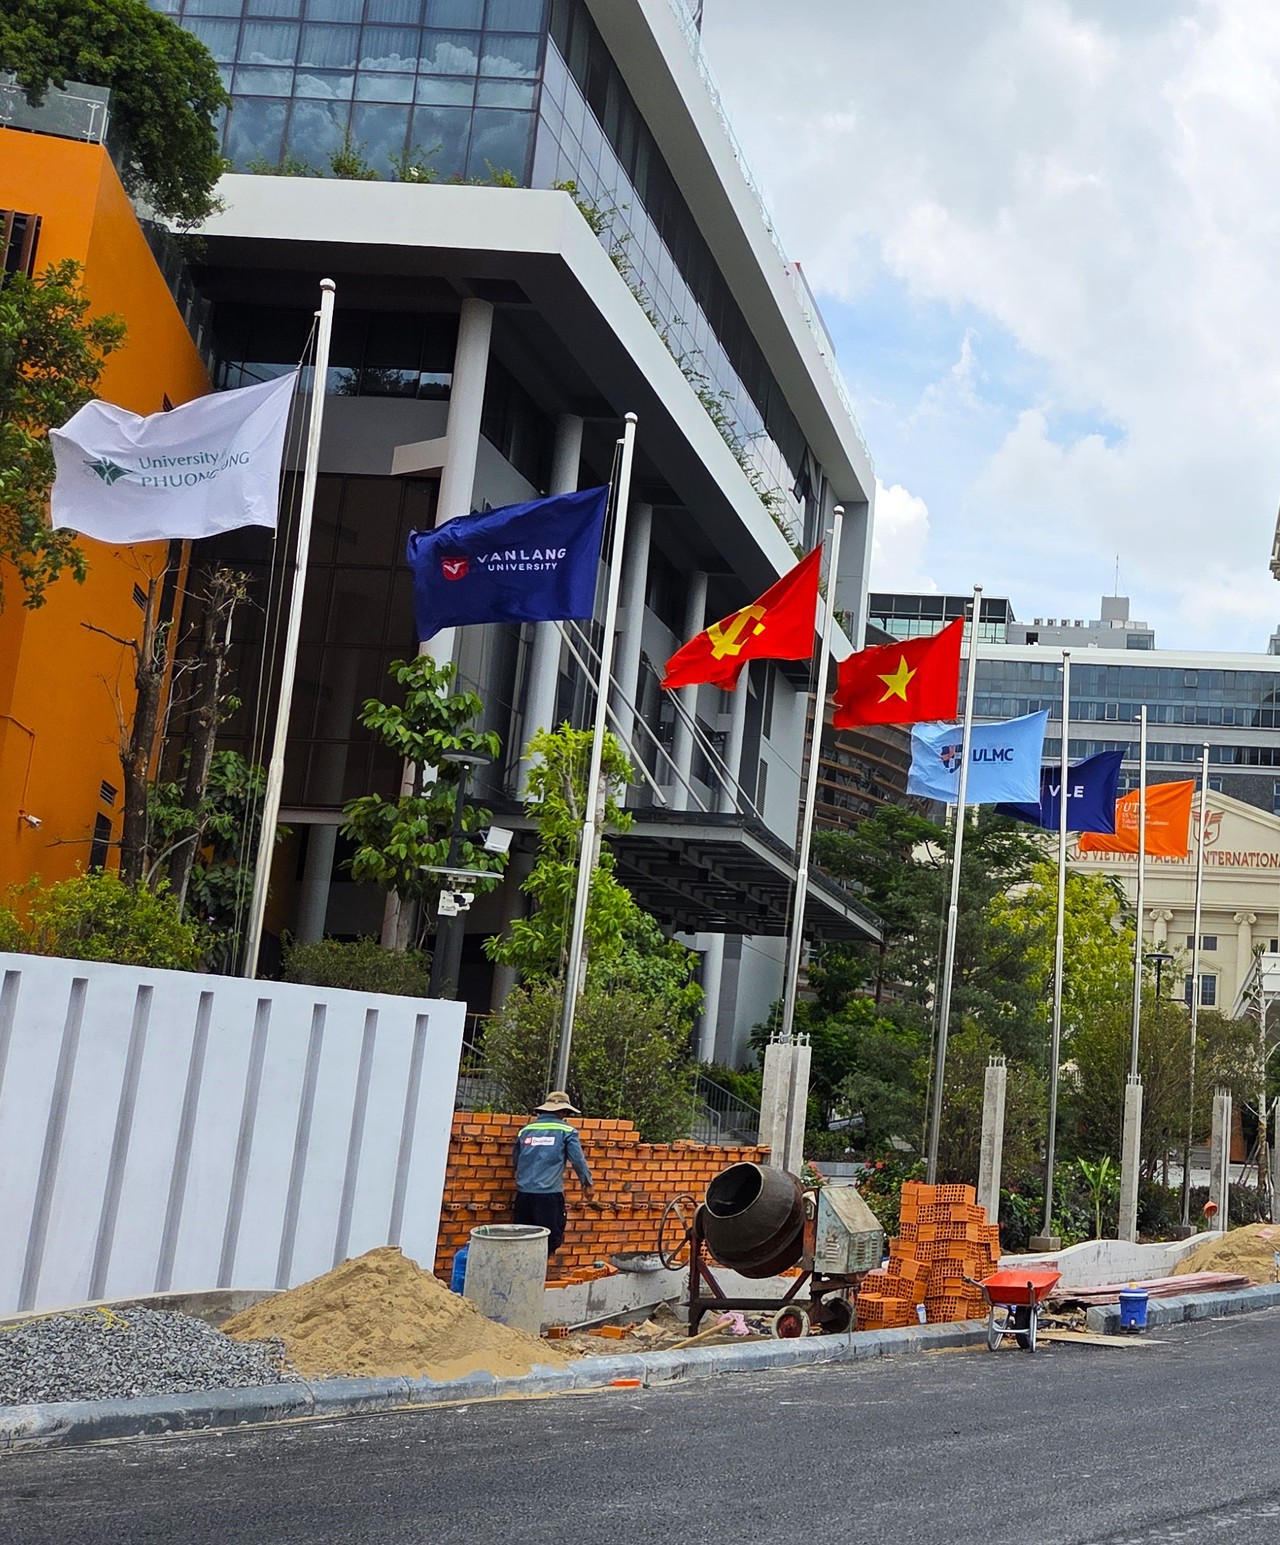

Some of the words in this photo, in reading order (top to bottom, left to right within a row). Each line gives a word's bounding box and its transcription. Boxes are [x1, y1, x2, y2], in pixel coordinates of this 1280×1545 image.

[139, 450, 219, 470] University
[487, 562, 558, 571] UNIVERSITY
[1123, 802, 1147, 813] UT
[1202, 850, 1280, 868] NTERNATION
